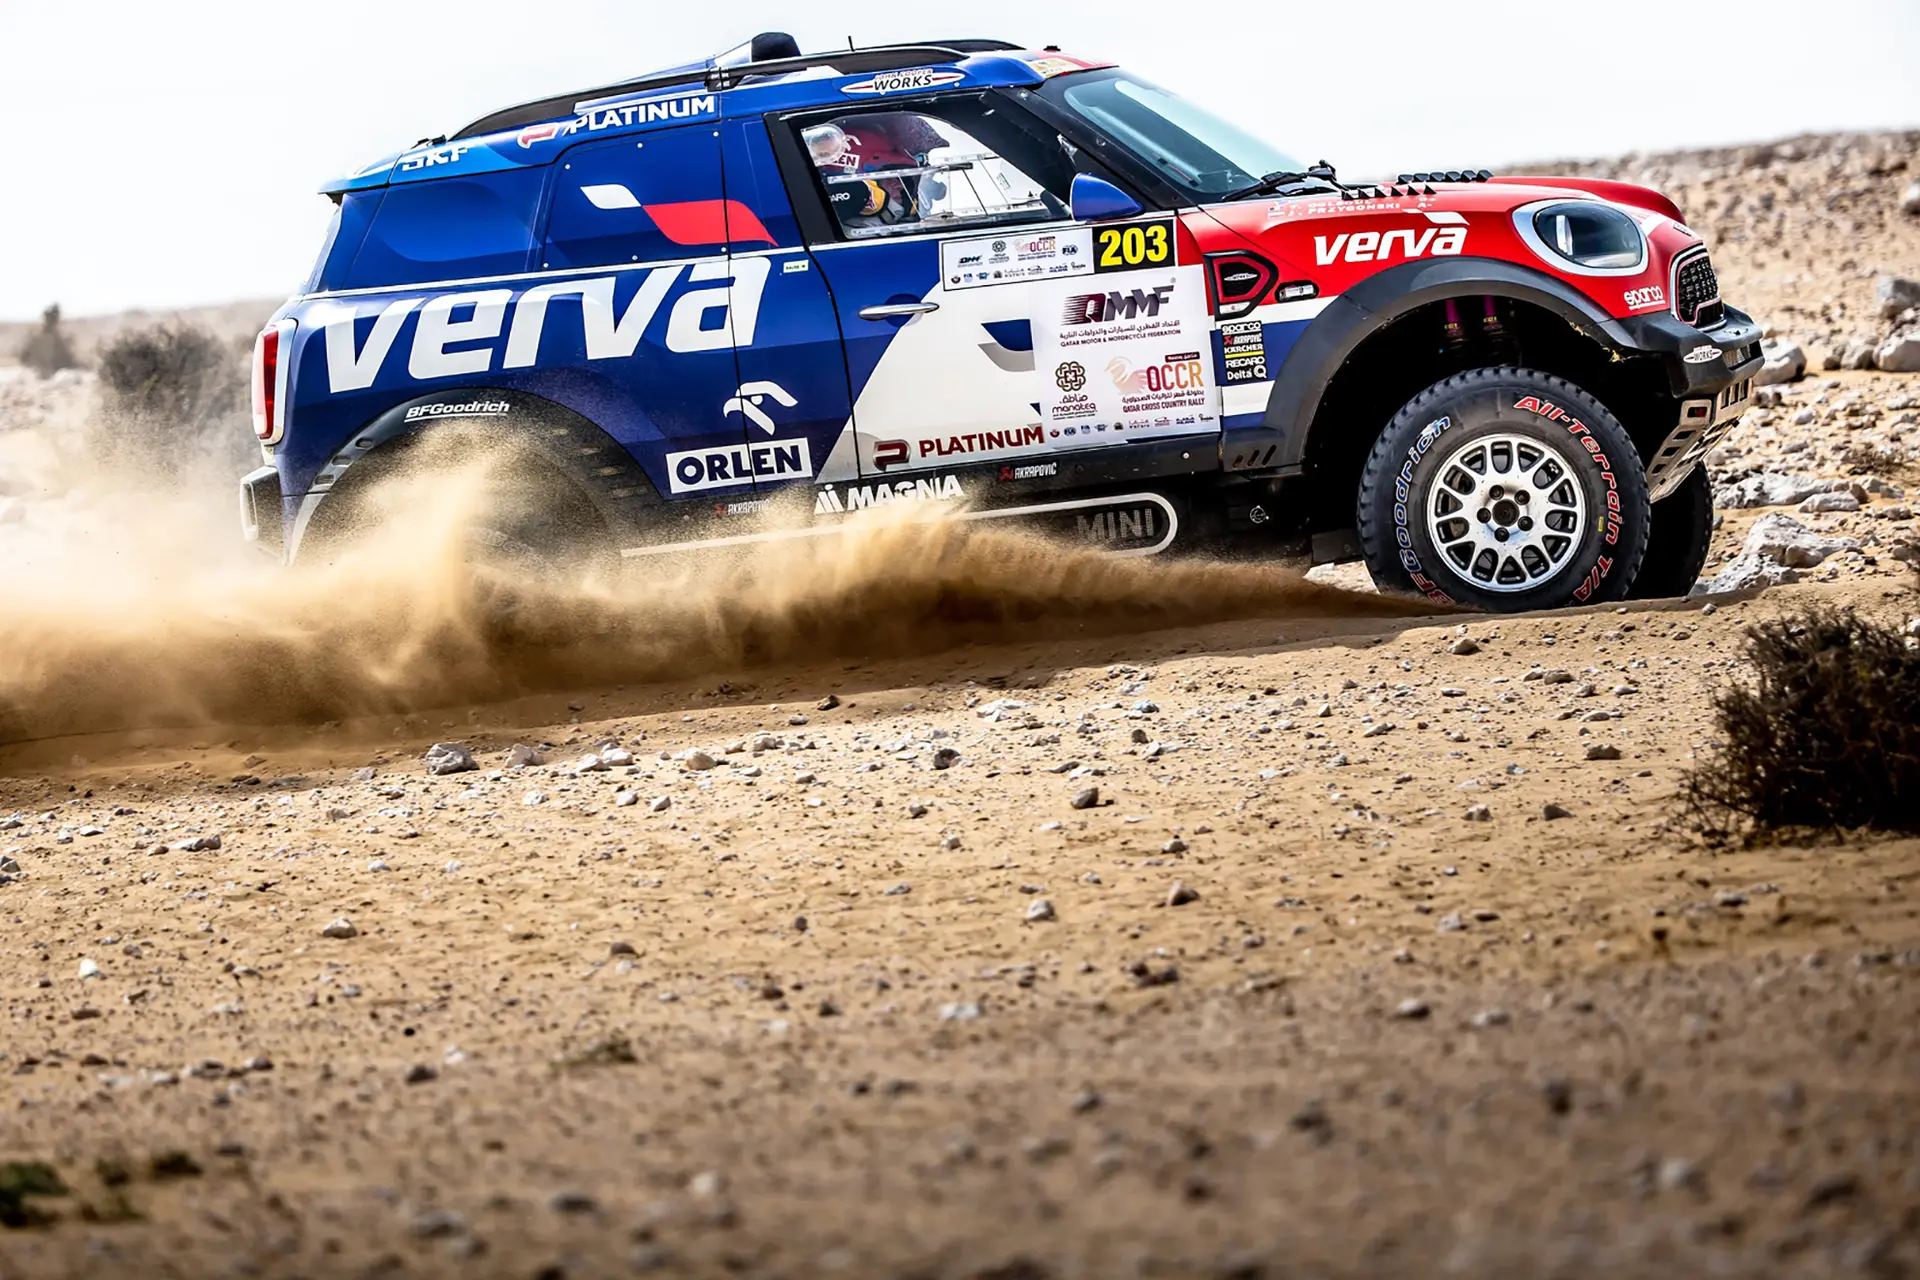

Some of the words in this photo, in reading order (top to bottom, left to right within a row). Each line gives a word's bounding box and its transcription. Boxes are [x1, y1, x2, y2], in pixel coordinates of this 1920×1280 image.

[874, 74, 932, 90] WORKS
[569, 96, 715, 134] PLATINUM
[1062, 245, 1077, 256] FIA
[1099, 225, 1169, 267] 203
[1313, 227, 1468, 266] verva
[1061, 285, 1174, 325] QMMF
[1624, 286, 1663, 307] sparco
[325, 256, 771, 394] verva
[1108, 333, 1146, 342] MOTORCYCLE
[1147, 329, 1181, 338] FEDERATION
[1221, 321, 1262, 334] sparco
[1146, 361, 1204, 392] QCCR
[1225, 356, 1265, 368] RECARO
[1227, 368, 1253, 380] Delta
[1254, 365, 1267, 379] Q
[406, 401, 510, 418] BFGoodrich
[1123, 404, 1140, 413] QATAR
[1142, 402, 1160, 411] CROSS
[1161, 400, 1187, 409] COUNTRY
[1188, 397, 1205, 406] RALLY
[919, 426, 1045, 458] PLATINUM
[676, 444, 803, 485] ORLEN
[847, 474, 965, 511] MAGNA
[1513, 396, 1622, 545] All-Terrain
[1573, 554, 1613, 601] T/A
[1077, 508, 1154, 541] MINI
